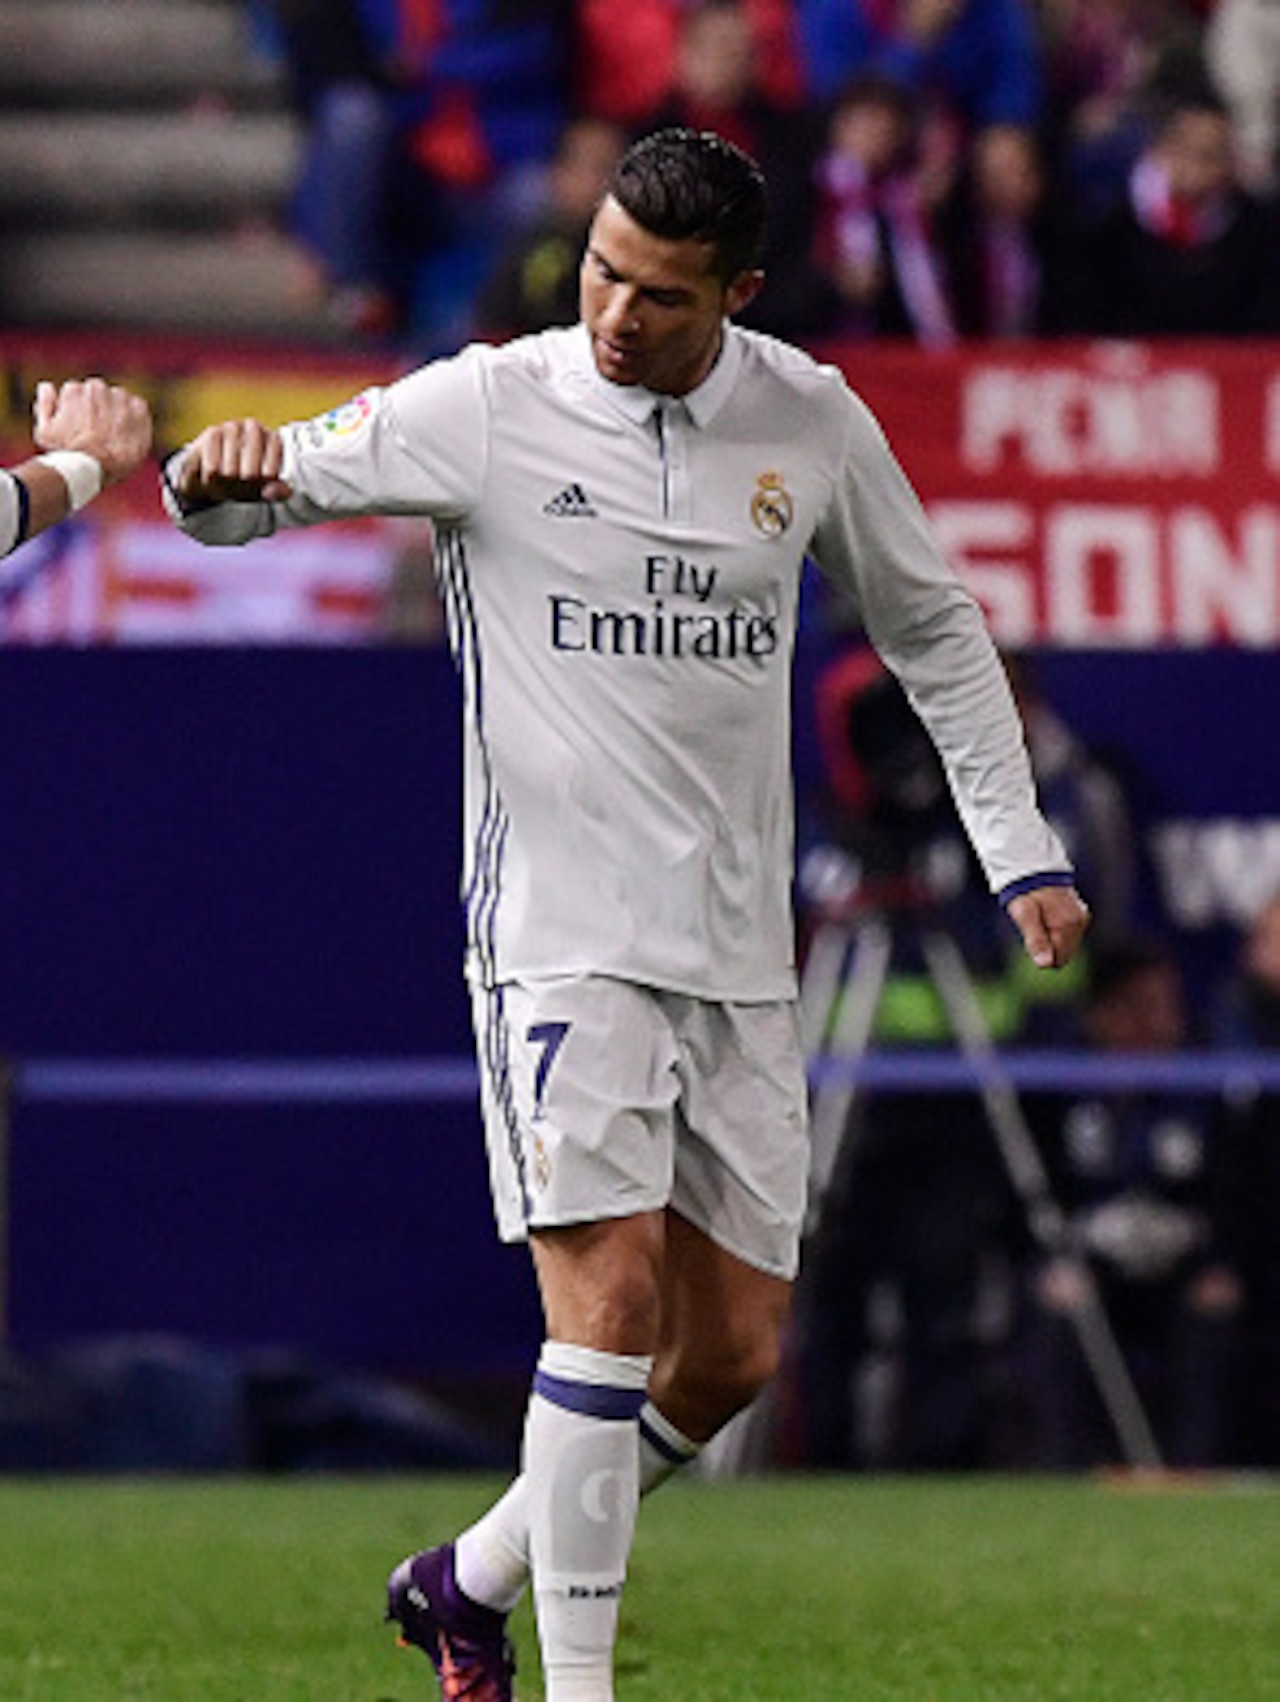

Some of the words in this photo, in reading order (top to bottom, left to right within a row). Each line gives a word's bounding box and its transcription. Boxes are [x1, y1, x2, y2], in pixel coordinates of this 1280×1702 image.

[645, 555, 718, 603] Fly
[547, 594, 778, 660] Emirates
[526, 1021, 573, 1121] 7
